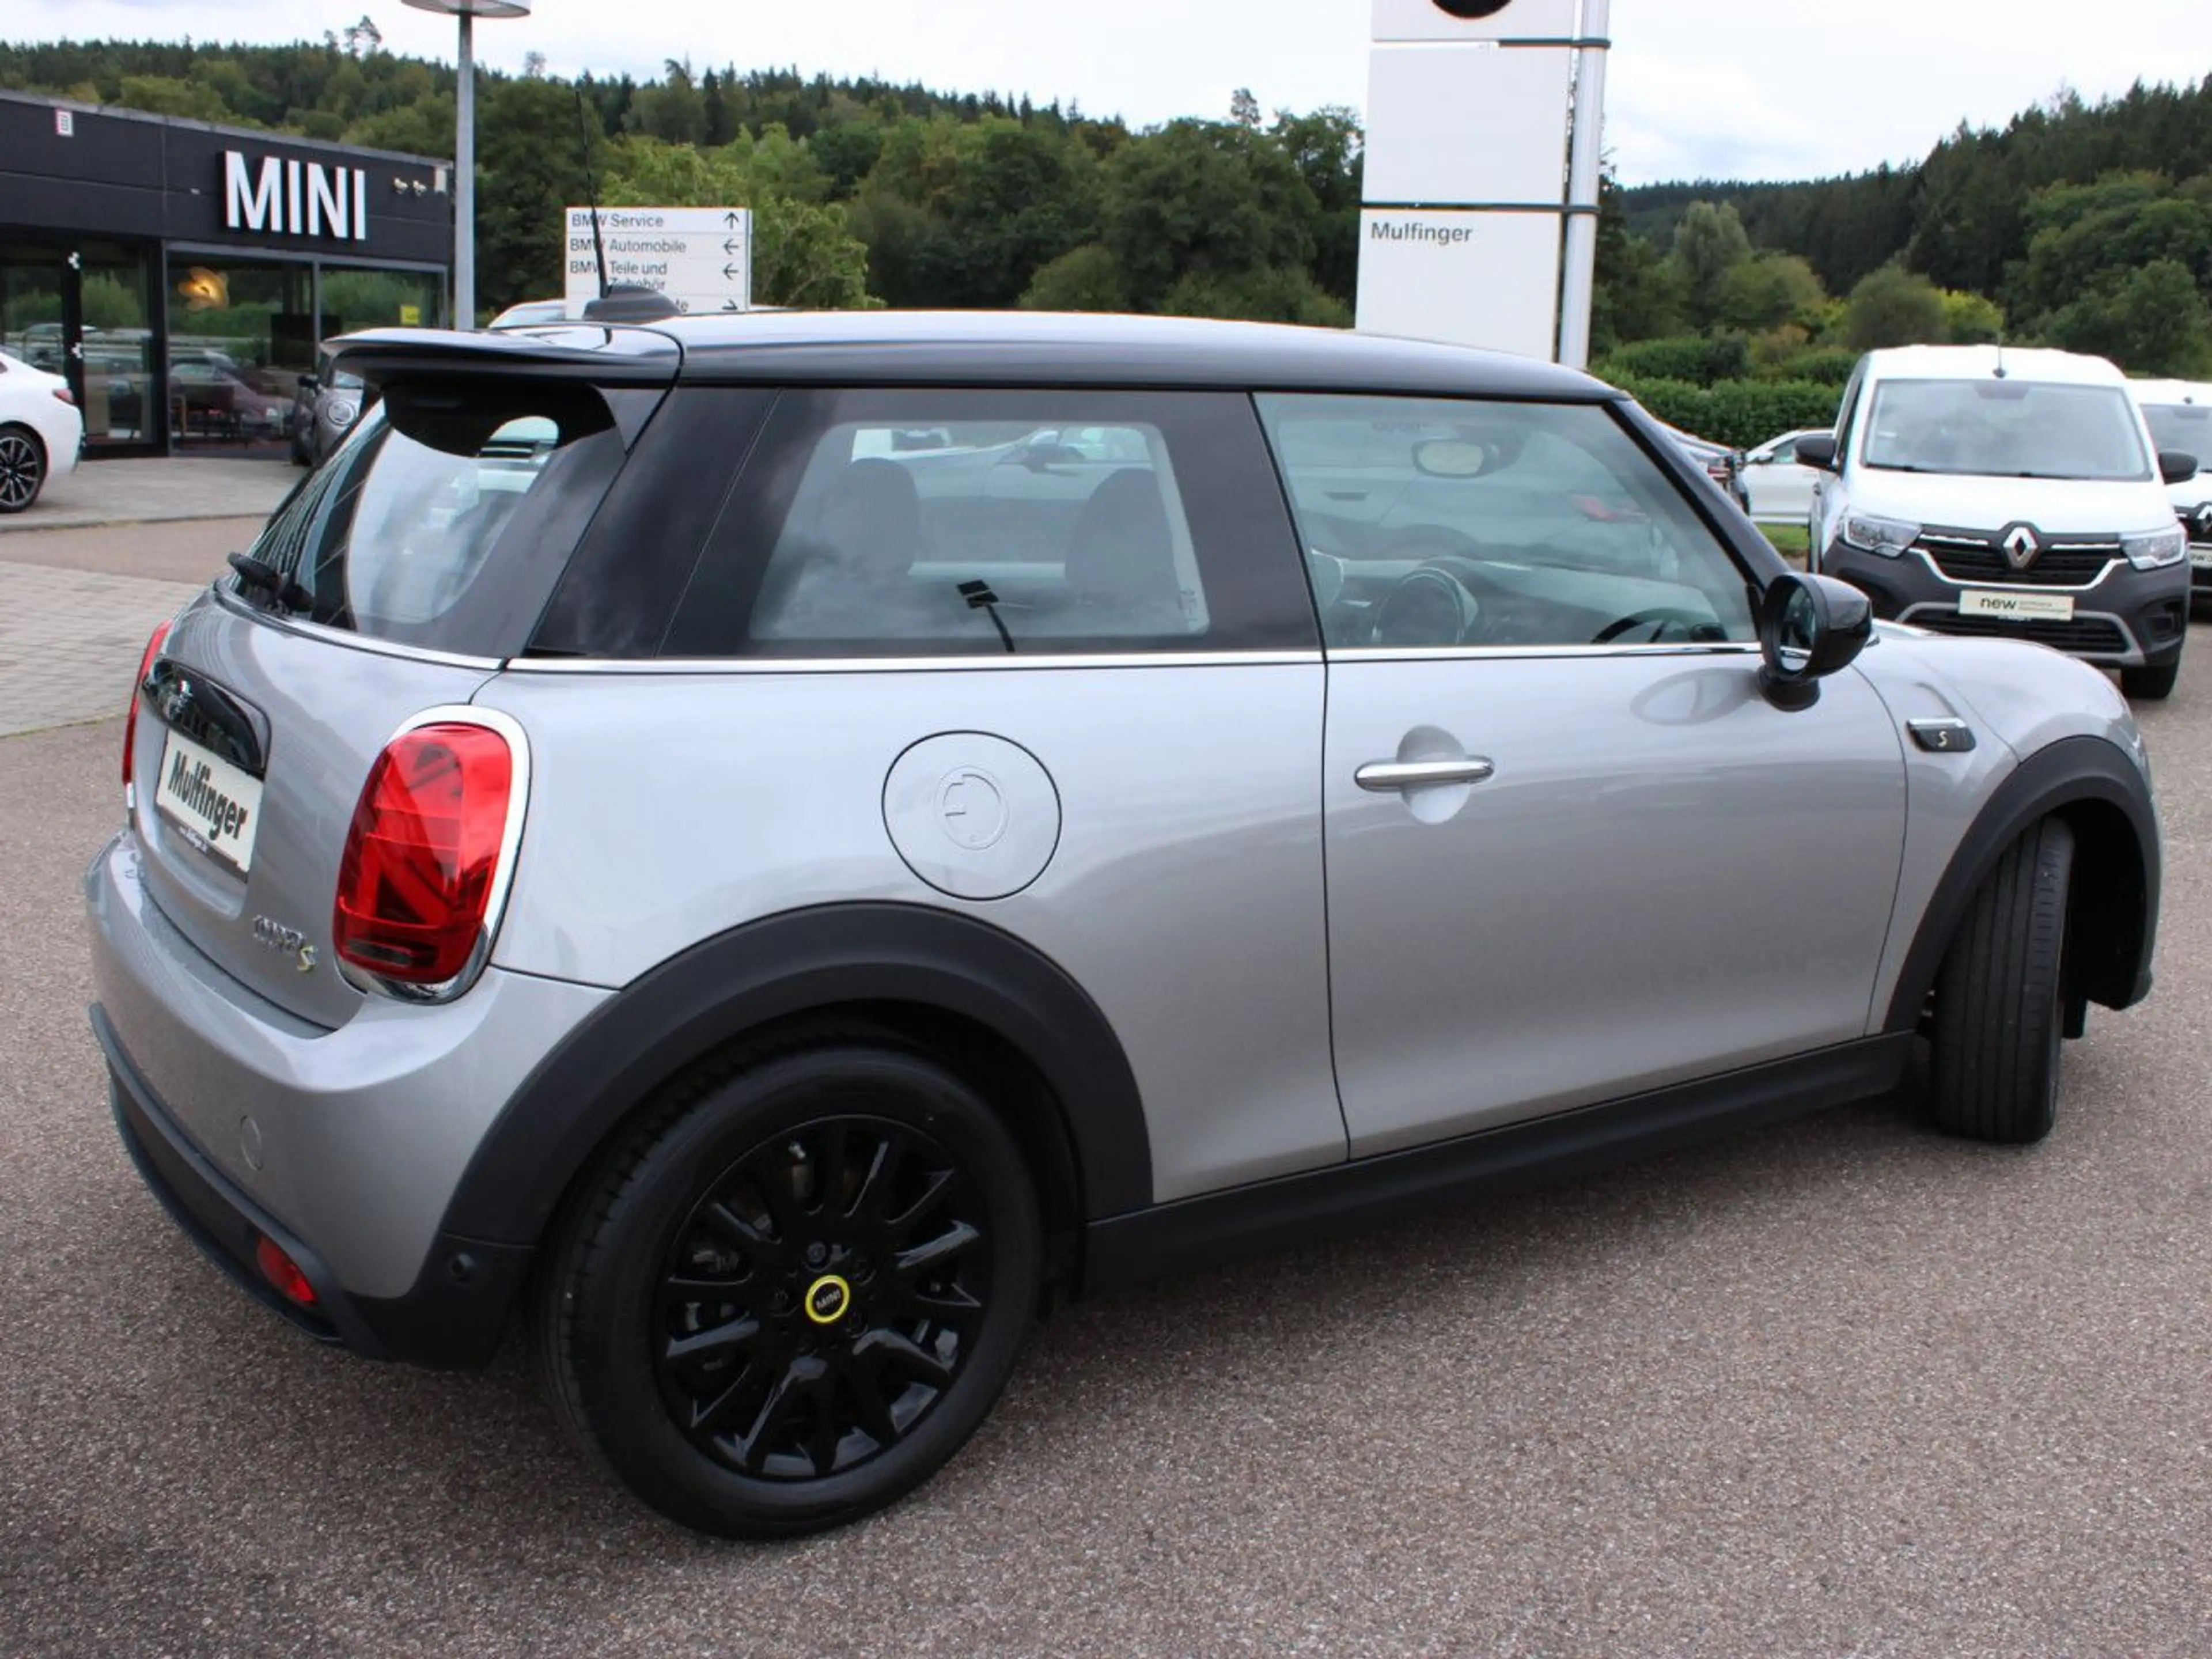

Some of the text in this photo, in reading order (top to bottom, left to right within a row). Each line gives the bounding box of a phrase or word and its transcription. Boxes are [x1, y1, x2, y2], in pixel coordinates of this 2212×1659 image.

[225, 150, 366, 240] MINI
[571, 213, 665, 227] BMW Service
[1370, 221, 1473, 246] Mulfinger
[609, 238, 687, 253] Automobile
[609, 261, 639, 275] Teile
[641, 262, 668, 275] und
[1979, 597, 2016, 609] new
[1937, 730, 1948, 748] S
[168, 749, 248, 840] Mulfinger
